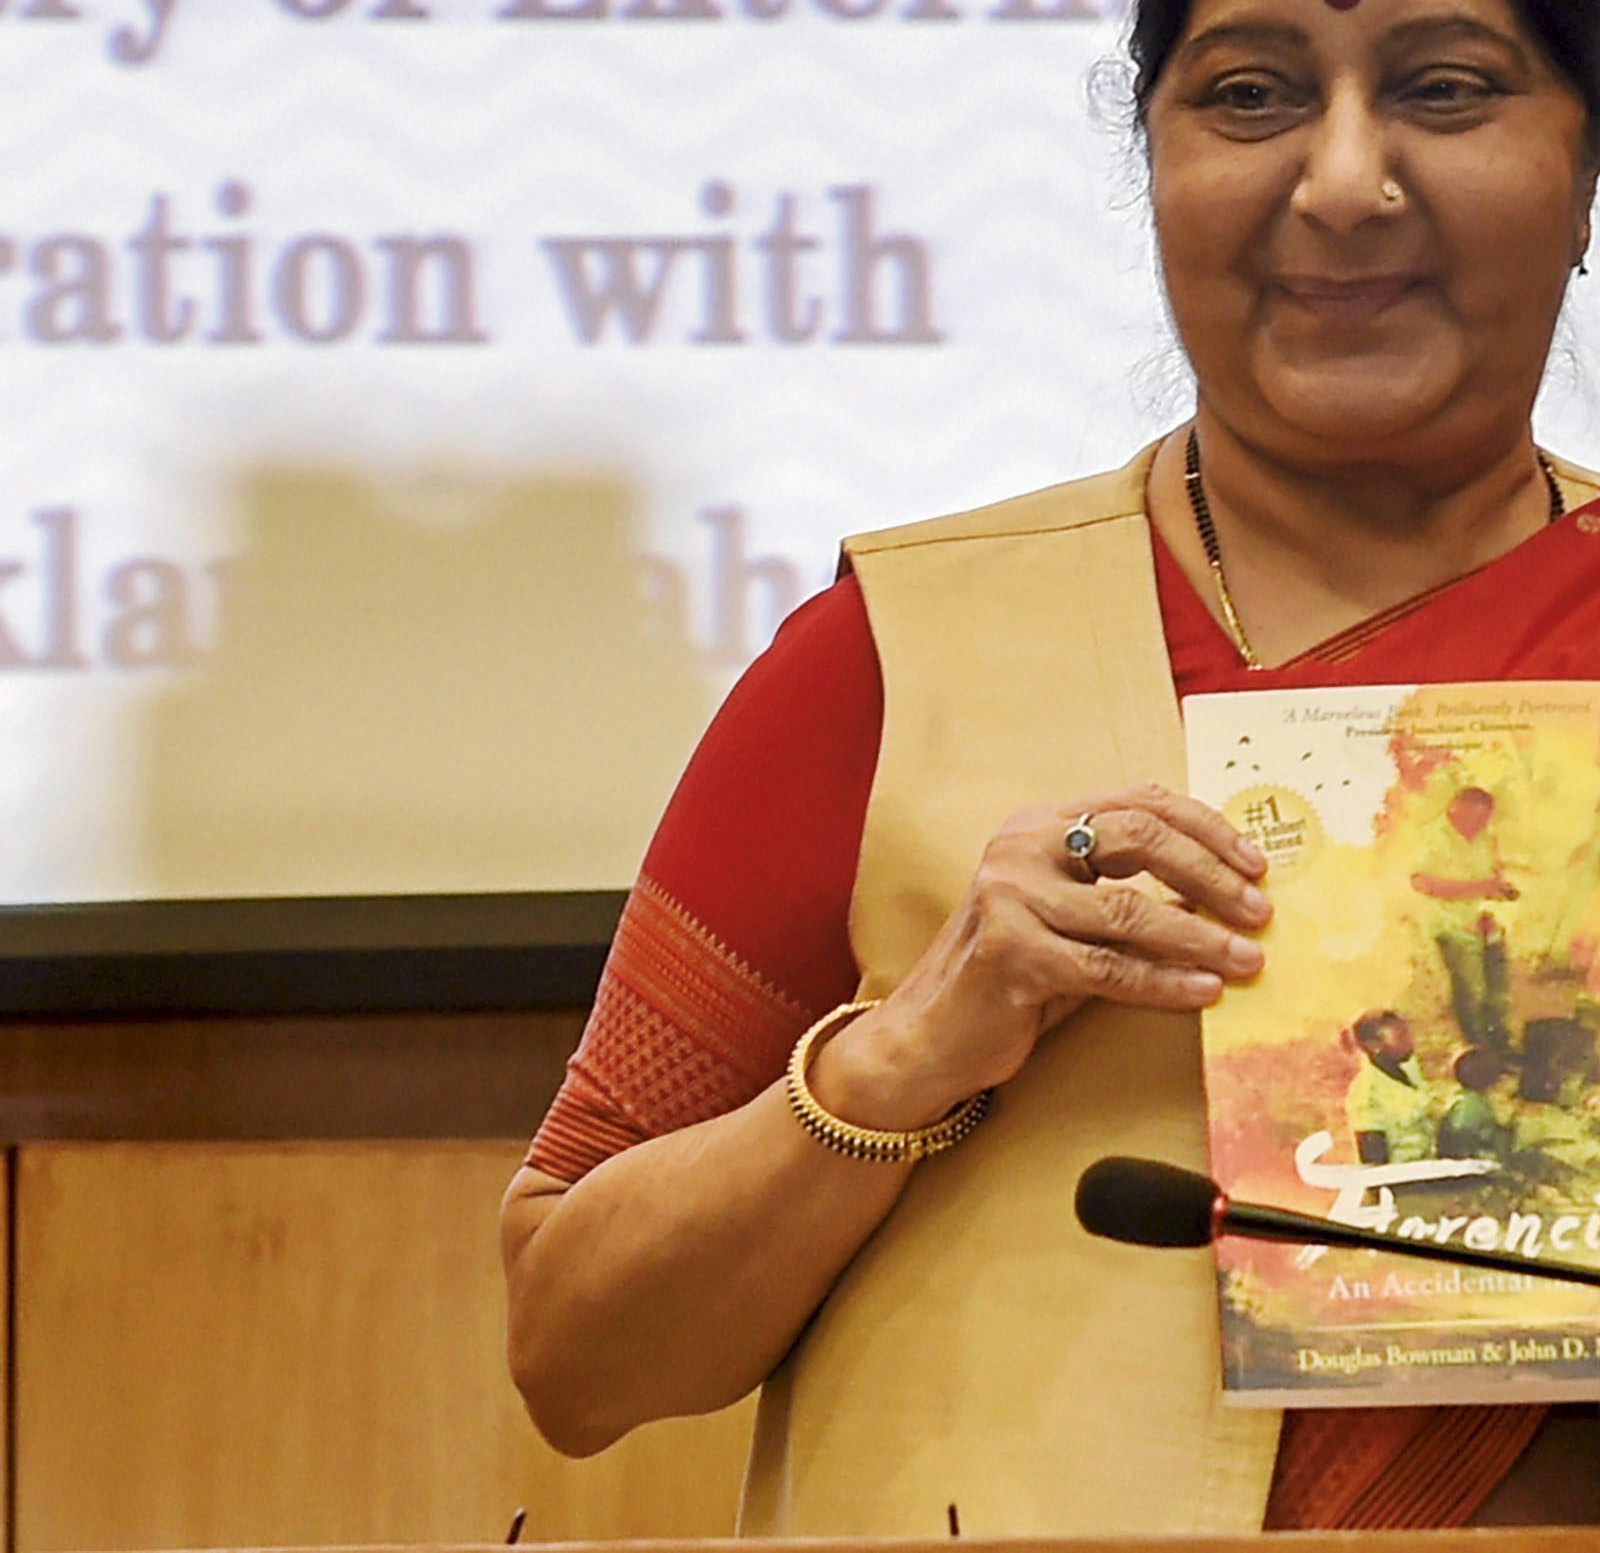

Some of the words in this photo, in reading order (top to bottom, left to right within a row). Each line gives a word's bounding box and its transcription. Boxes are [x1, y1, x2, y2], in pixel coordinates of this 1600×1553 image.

[0, 180, 490, 346] ation
[540, 180, 948, 346] with
[1242, 795, 1281, 828] #1
[1328, 1275, 1371, 1300] An
[1298, 1346, 1381, 1375] Douglas
[1385, 1344, 1477, 1365] Bowman
[1481, 1342, 1504, 1362] &
[1508, 1338, 1557, 1366] John
[1562, 1337, 1591, 1359] D.
